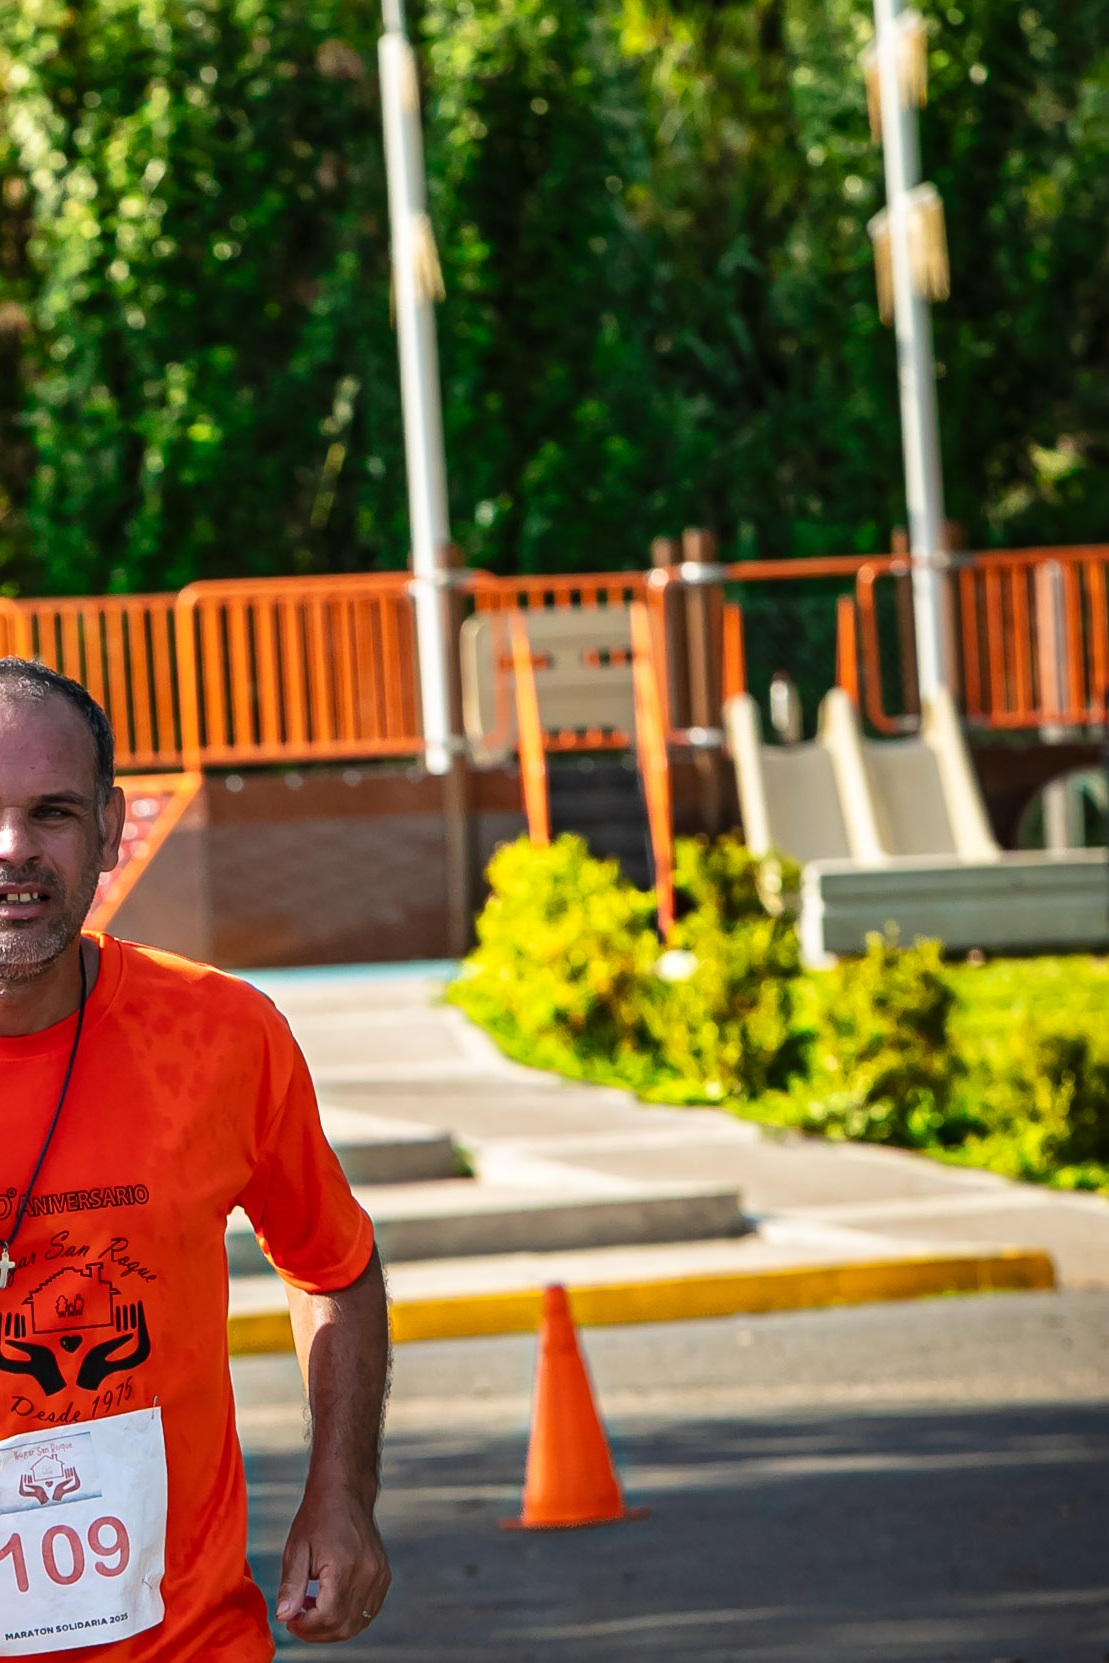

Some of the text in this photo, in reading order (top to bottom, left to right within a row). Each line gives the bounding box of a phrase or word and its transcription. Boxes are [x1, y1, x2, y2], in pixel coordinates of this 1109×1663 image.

[16, 1184, 150, 1218] ANIVERSARIO
[45, 1230, 91, 1260] San
[98, 1237, 158, 1284] Roque
[11, 1375, 133, 1424] Desde 1975
[4, 1626, 54, 1641] MARATON
[55, 1617, 108, 1633] SOLIDARIA
